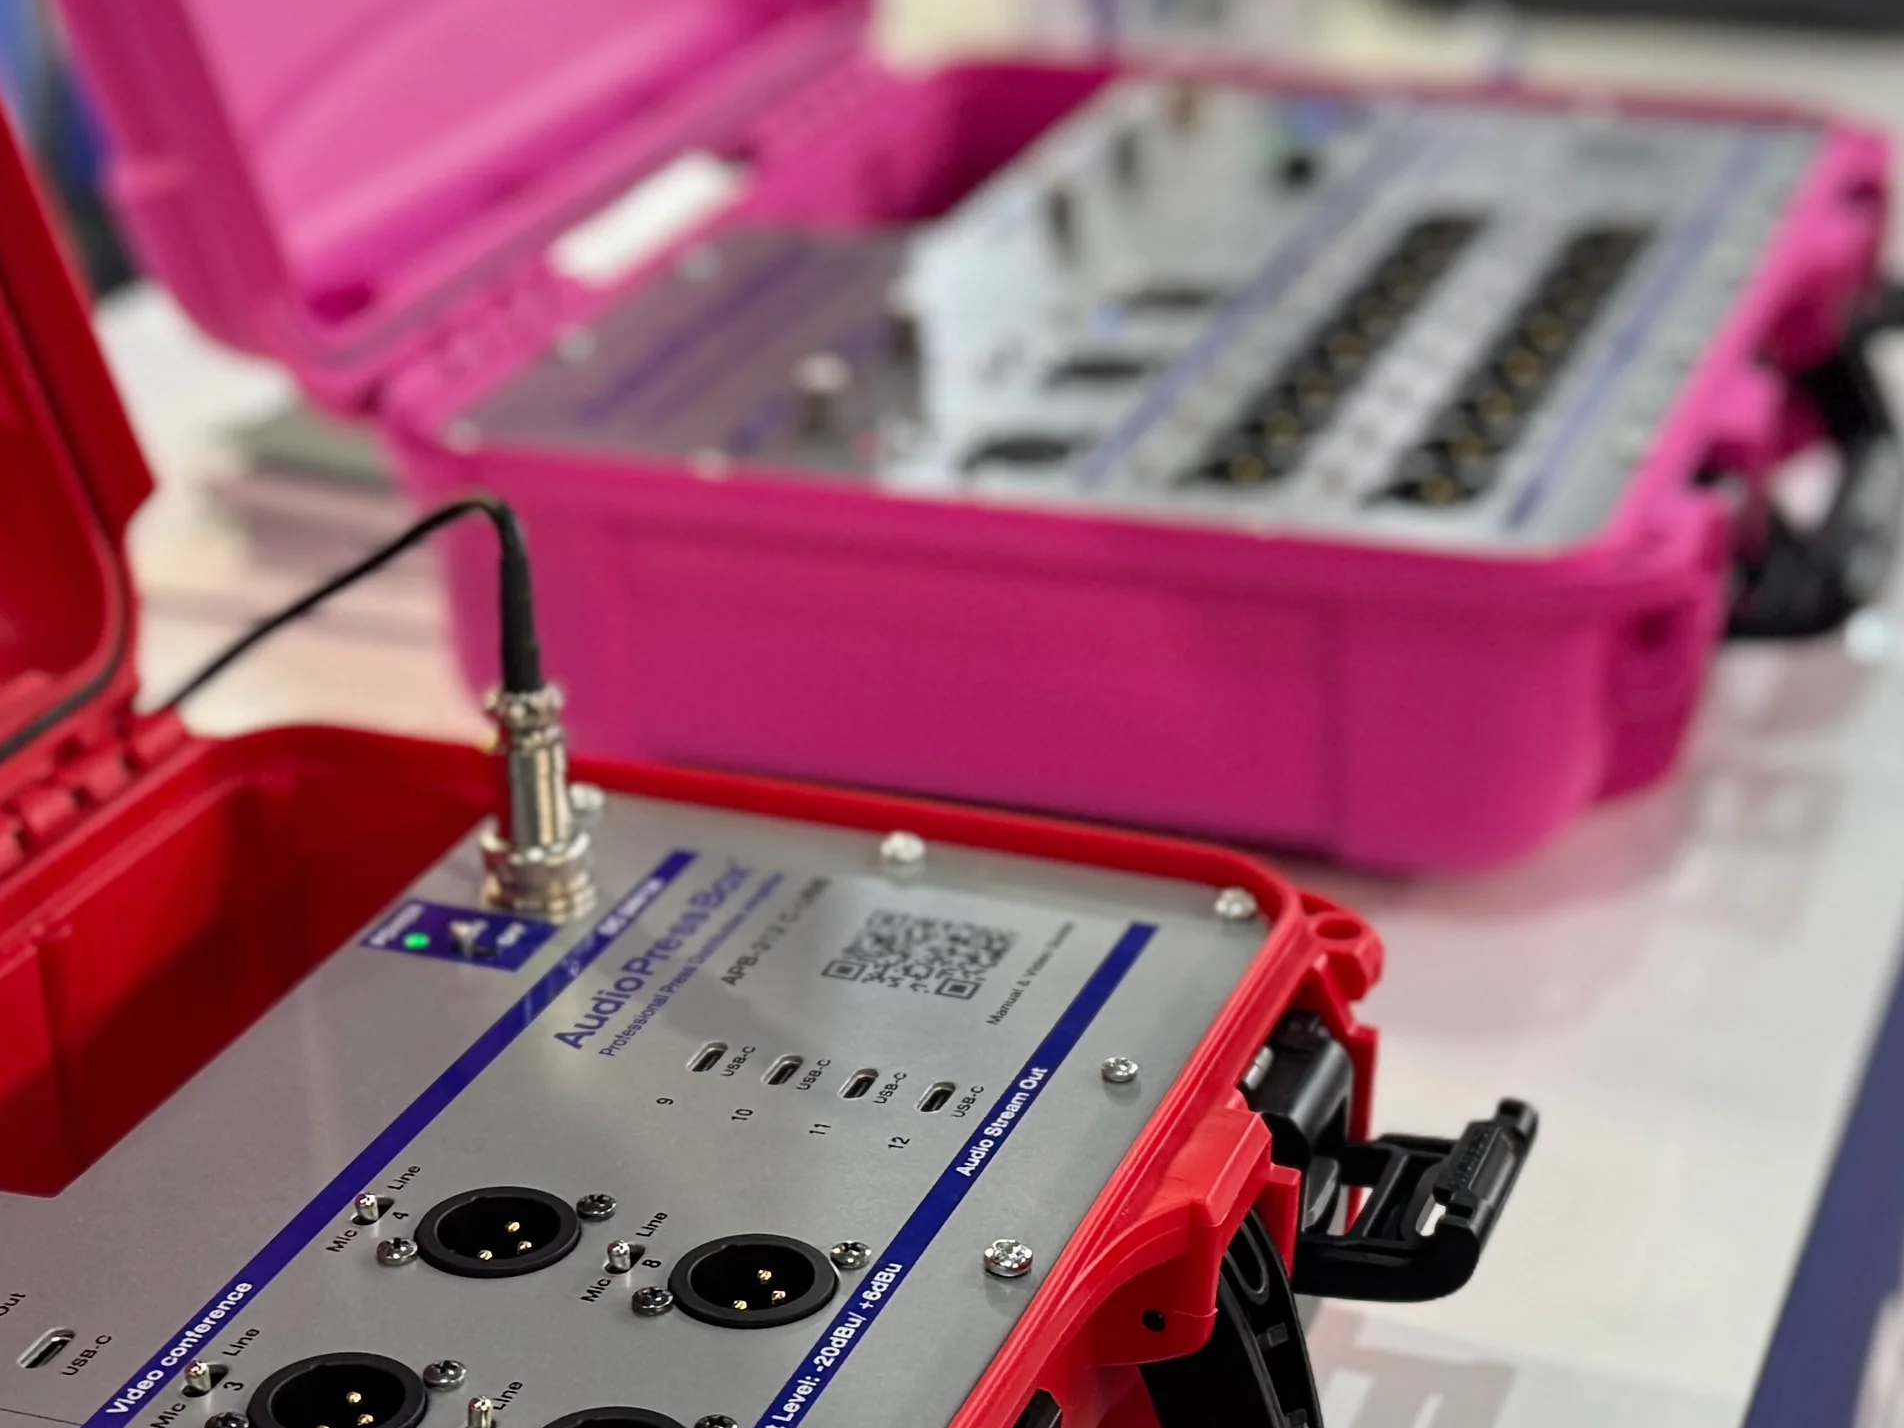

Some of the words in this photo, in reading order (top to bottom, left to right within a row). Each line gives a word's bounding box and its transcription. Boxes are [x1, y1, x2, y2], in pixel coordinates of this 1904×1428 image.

[554, 857, 752, 1049] AudioPressBox
[599, 993, 668, 1057] Professional
[661, 963, 694, 995] Press
[986, 988, 1024, 1025] Manual
[722, 1046, 756, 1077] USB-C
[797, 1059, 832, 1091] USB-C
[656, 1097, 674, 1105] 9
[873, 1072, 907, 1104] USB-C
[951, 1085, 984, 1118] USB-C
[731, 1108, 753, 1121] 10
[809, 1123, 831, 1135] 11
[956, 1139, 994, 1177] Audio
[983, 1091, 1030, 1137] Stream
[1019, 1066, 1048, 1090] Out
[888, 1136, 910, 1150] 12
[387, 1165, 421, 1191] Line
[637, 1210, 668, 1238] Line
[326, 1228, 358, 1253] Mic
[642, 1259, 662, 1269] 8
[580, 1276, 611, 1304] Mic
[62, 1334, 112, 1376] USB-C
[106, 1370, 163, 1415] Video
[161, 1281, 253, 1367] conference
[222, 1327, 260, 1357] Line
[772, 1375, 821, 1423] Level:
[816, 1312, 868, 1373] -20dBu/
[859, 1263, 903, 1311] +6dBu
[223, 1380, 244, 1392] 3
[492, 1380, 523, 1411] Line
[150, 1402, 187, 1428] Mic
